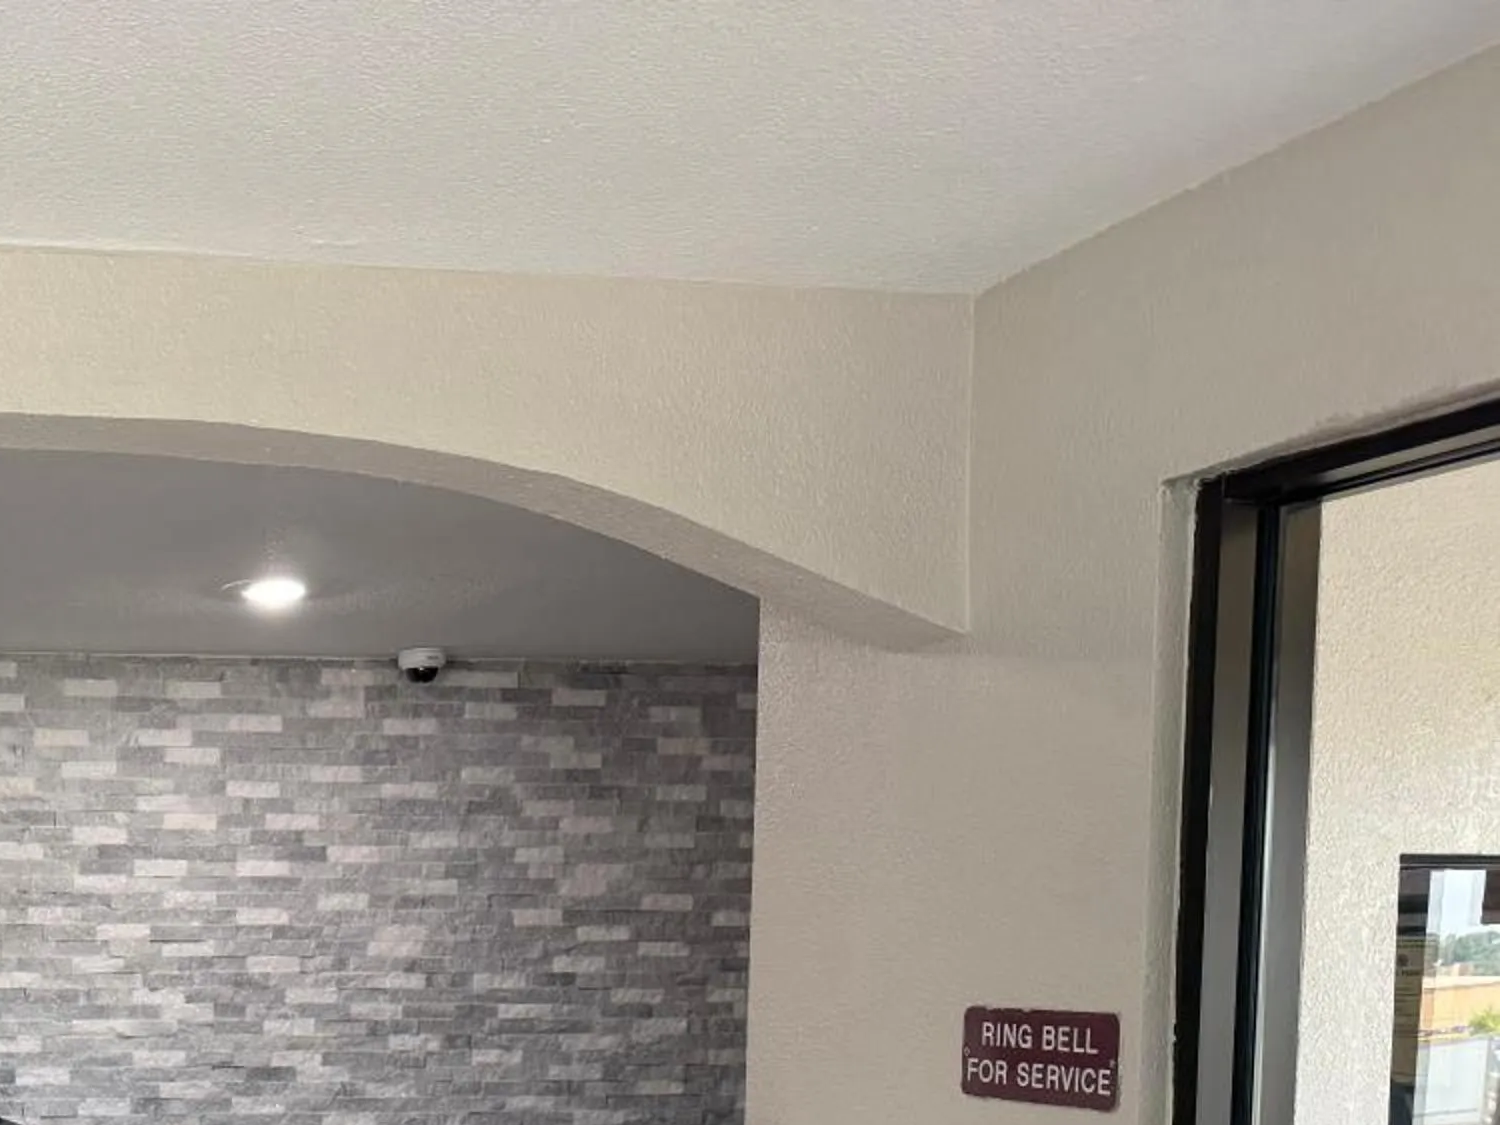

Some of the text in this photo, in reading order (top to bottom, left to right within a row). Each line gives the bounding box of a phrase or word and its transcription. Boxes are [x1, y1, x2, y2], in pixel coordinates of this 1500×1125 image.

[982, 1021, 1099, 1055] RING BELL
[966, 1057, 1111, 1095] FOR SERVICE
